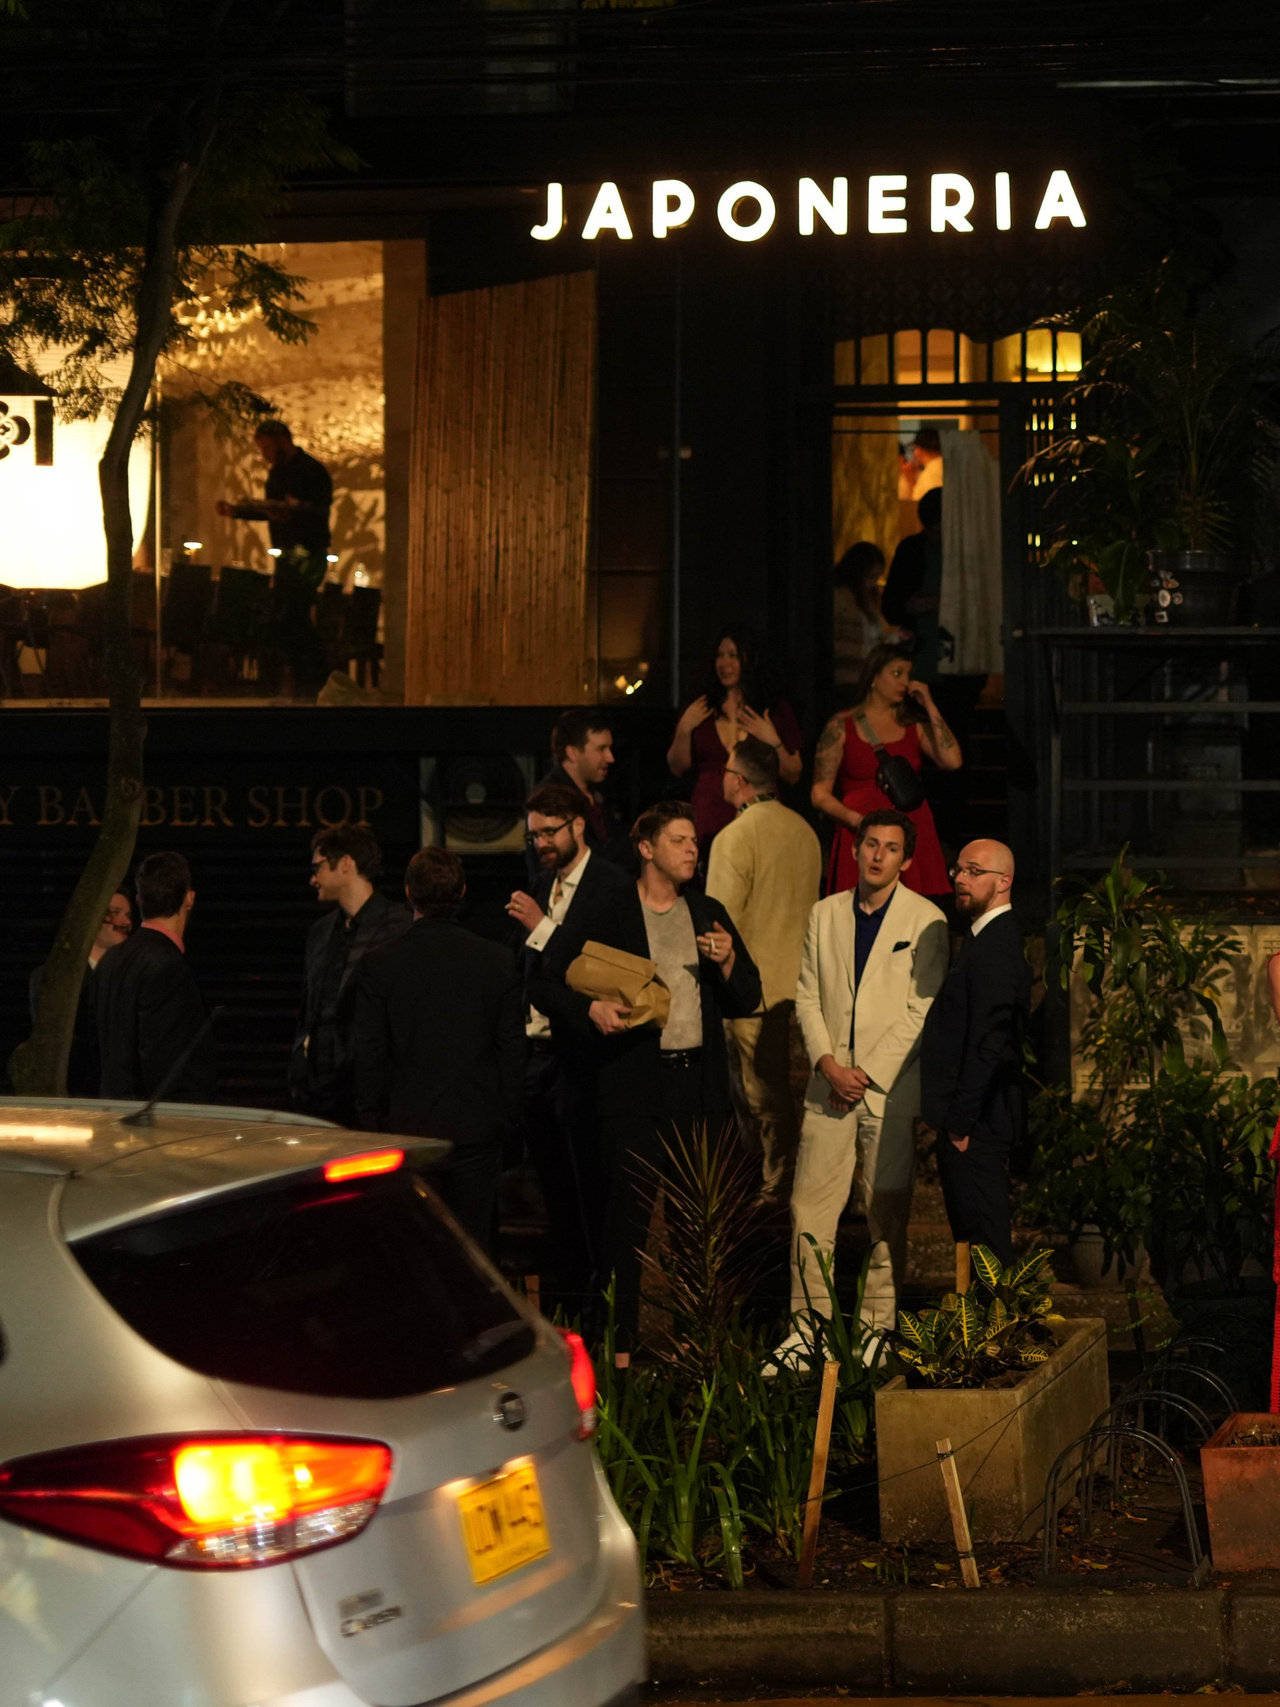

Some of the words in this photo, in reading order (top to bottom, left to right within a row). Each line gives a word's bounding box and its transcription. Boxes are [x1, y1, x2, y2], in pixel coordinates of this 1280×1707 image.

[530, 169, 1087, 242] JAPONERIA
[36, 784, 235, 827] BABER
[248, 785, 383, 827] SHOP
